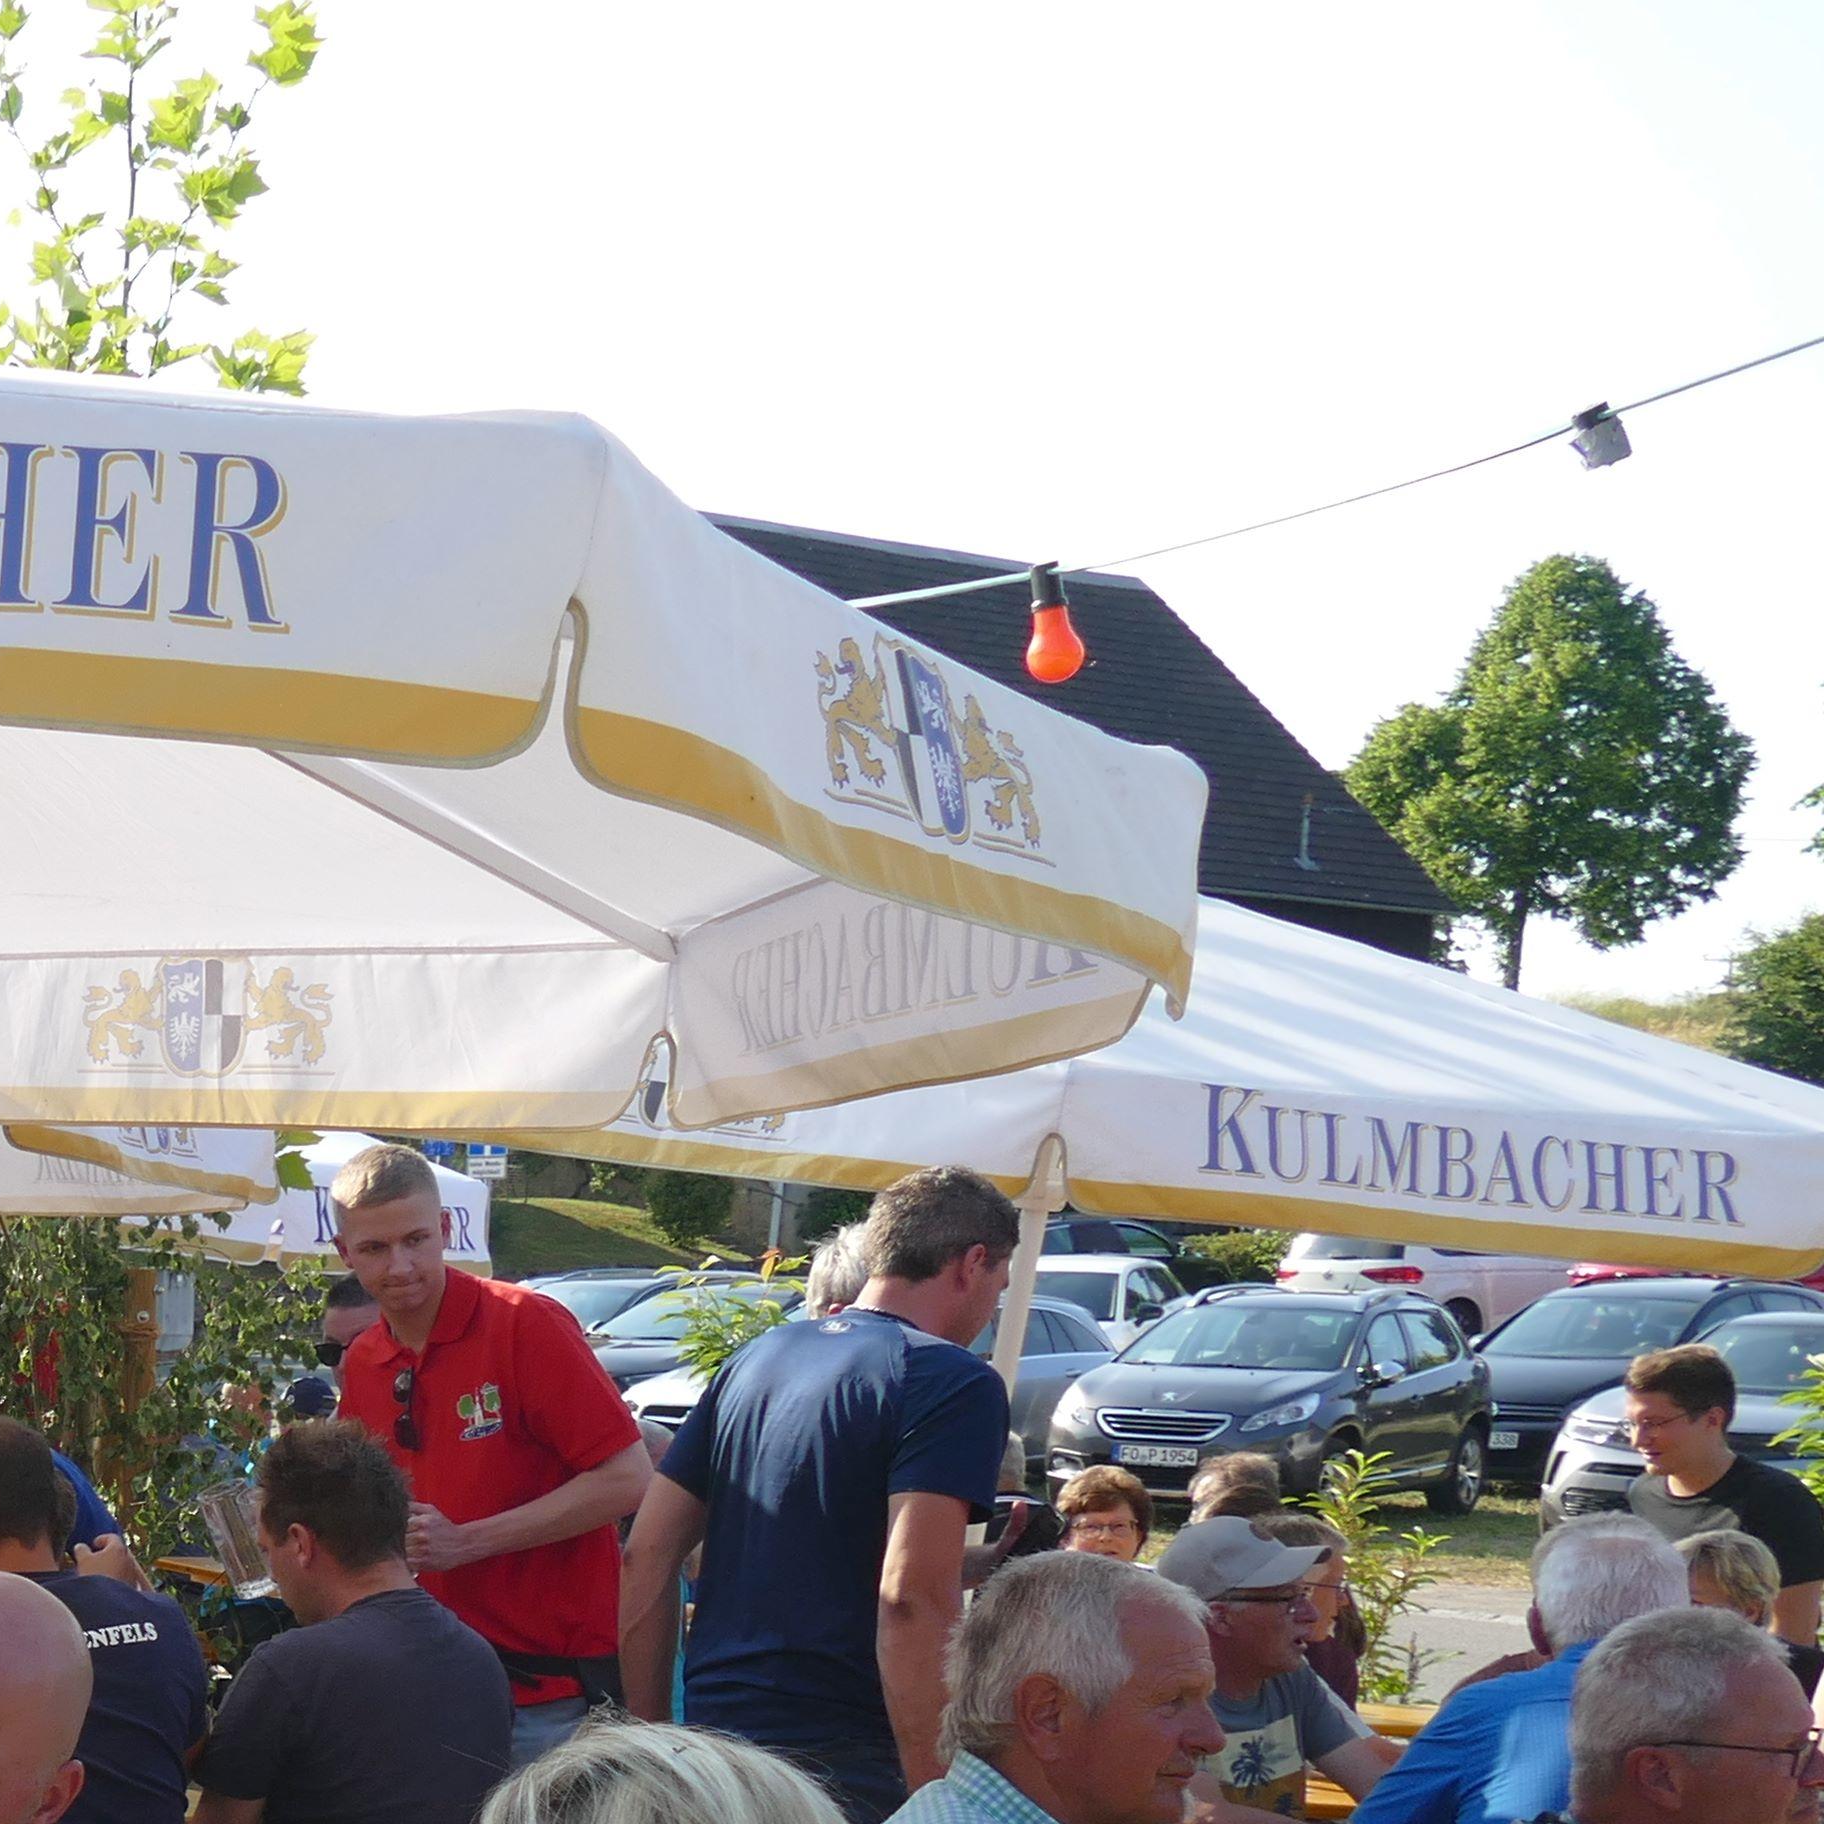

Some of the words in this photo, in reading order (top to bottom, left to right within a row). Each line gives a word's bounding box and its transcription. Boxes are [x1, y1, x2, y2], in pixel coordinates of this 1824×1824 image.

[1198, 1081, 1746, 1228] KULMBACHER
[1121, 1446, 1140, 1460] FO
[1149, 1448, 1157, 1461] P
[1160, 1449, 1196, 1463] 1954
